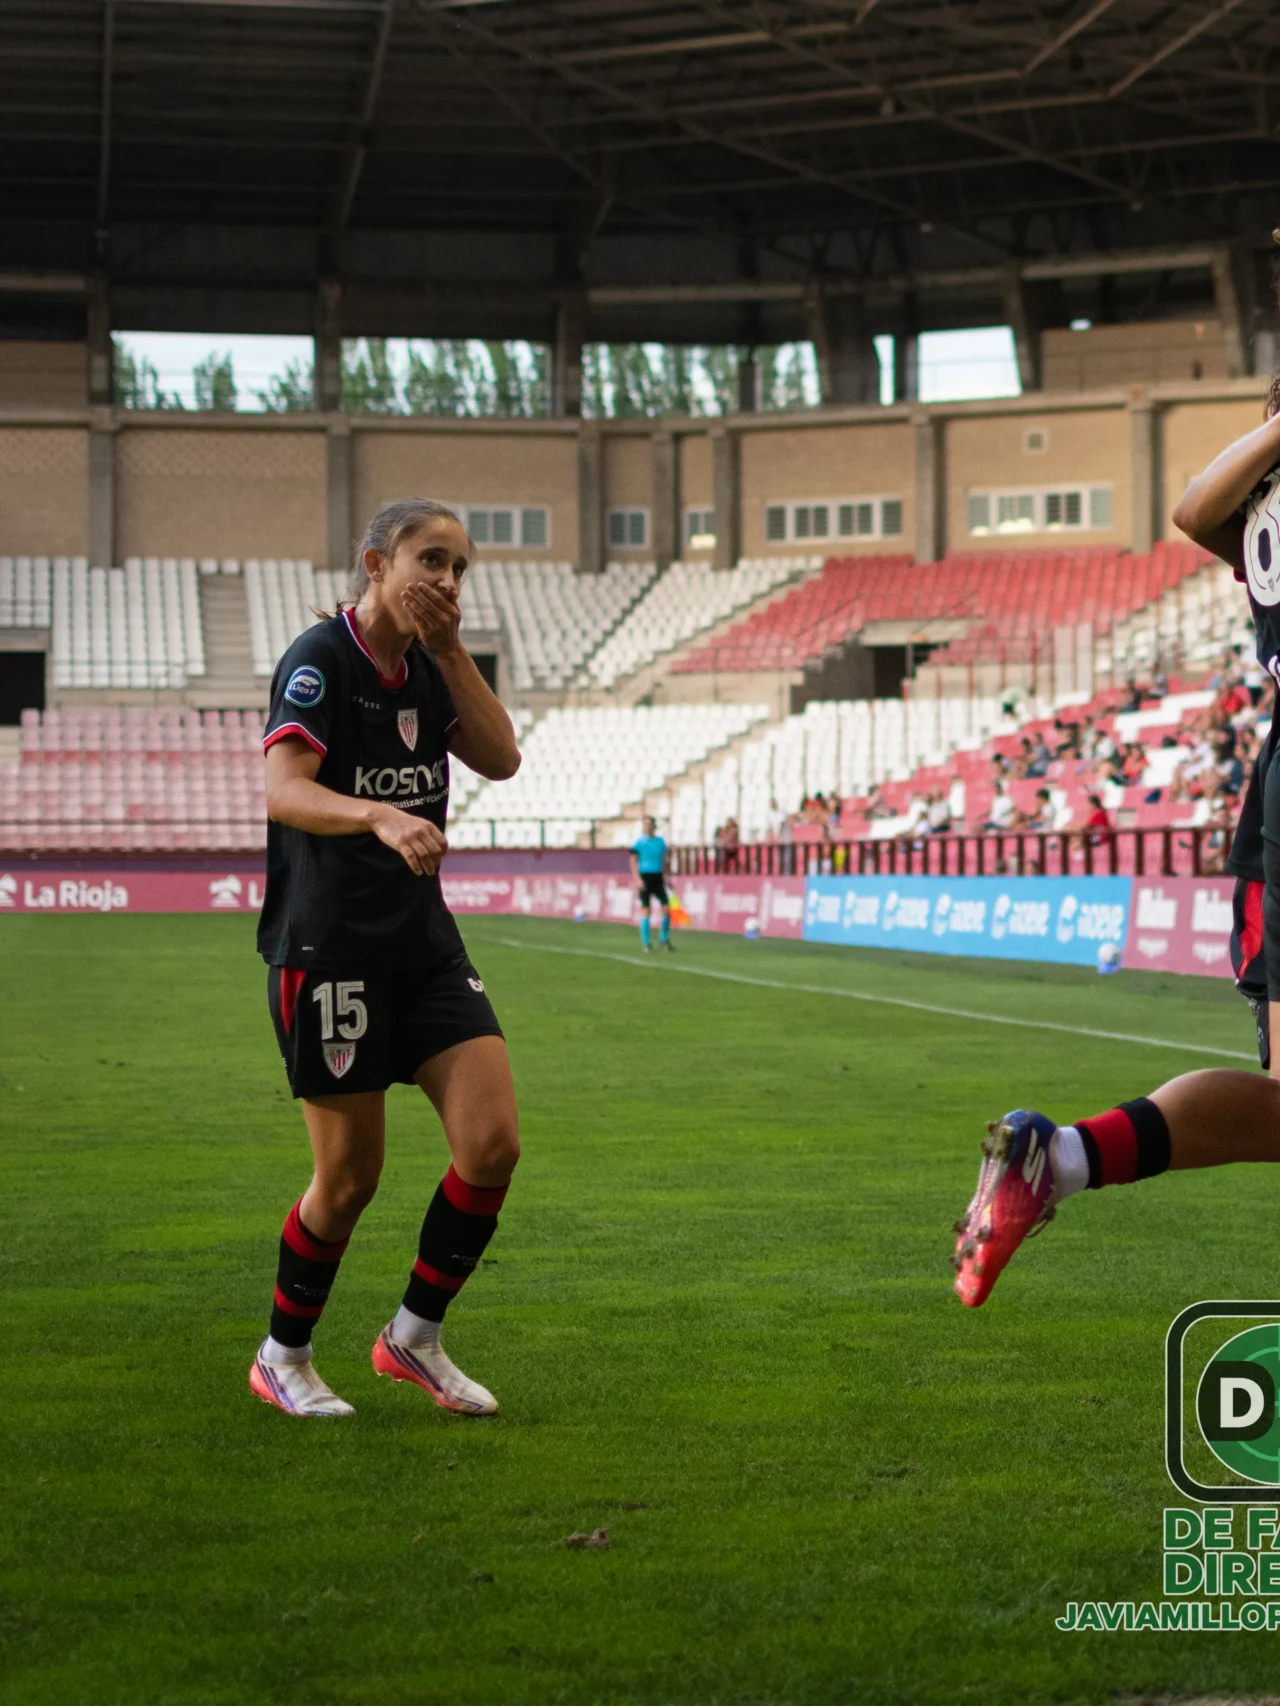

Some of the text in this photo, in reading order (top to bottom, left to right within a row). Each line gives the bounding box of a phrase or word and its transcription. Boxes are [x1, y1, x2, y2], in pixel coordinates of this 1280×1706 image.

[292, 683, 309, 694] Liga
[24, 879, 129, 912] La Rioja
[312, 980, 368, 1041] 15
